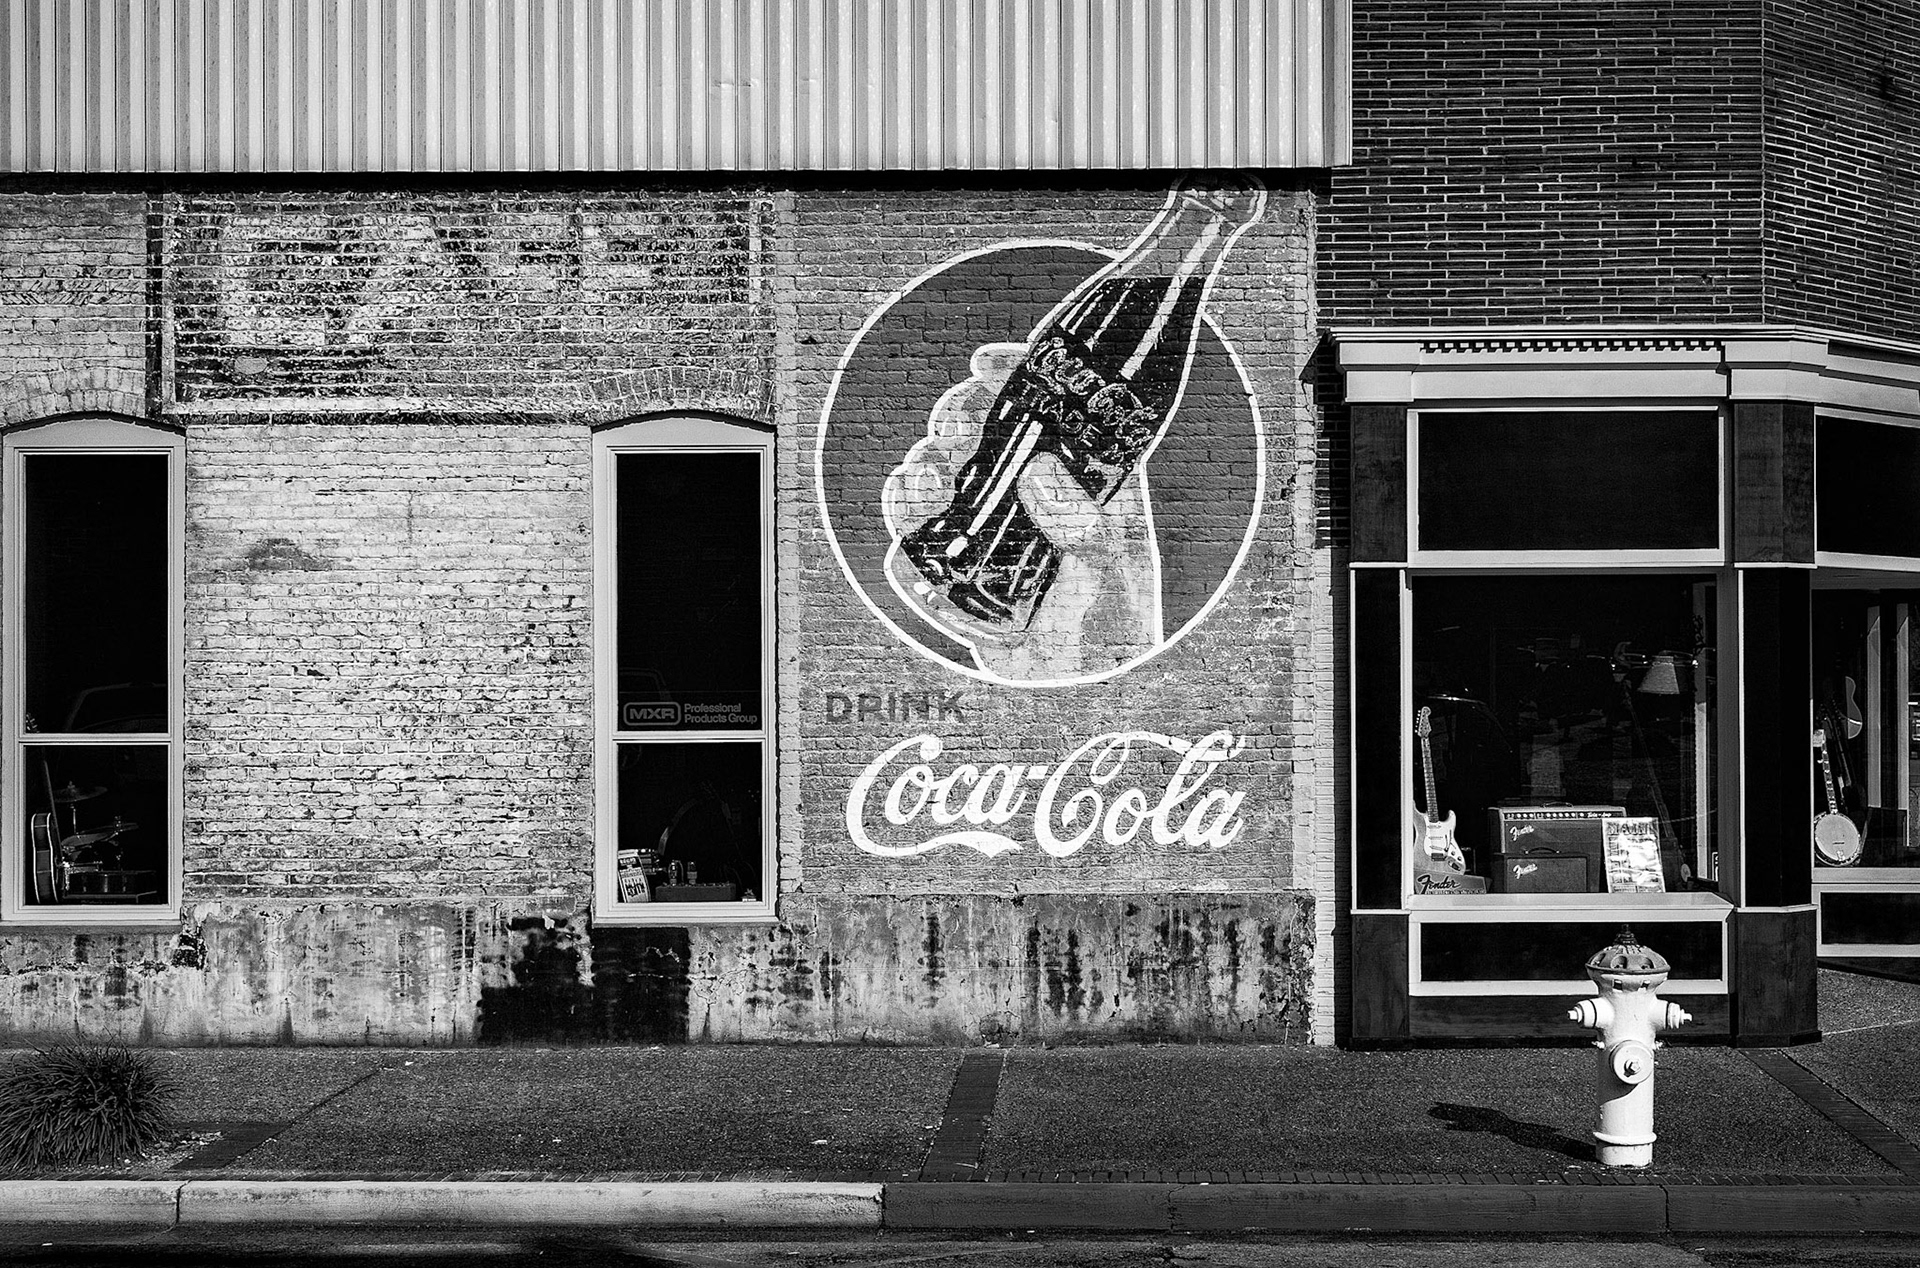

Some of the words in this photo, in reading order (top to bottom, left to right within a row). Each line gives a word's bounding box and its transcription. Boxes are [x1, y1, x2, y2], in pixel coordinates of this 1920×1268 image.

[1021, 378, 1104, 448] TRADE
[629, 708, 676, 720] MXR
[684, 703, 742, 713] Professional
[825, 691, 966, 725] DRINK
[684, 713, 727, 724] Products
[728, 713, 758, 725] Group
[846, 730, 1246, 859] Coca-Cola
[1509, 824, 1535, 842] Fender
[1512, 863, 1538, 880] Fender
[1416, 873, 1461, 894] Fender
